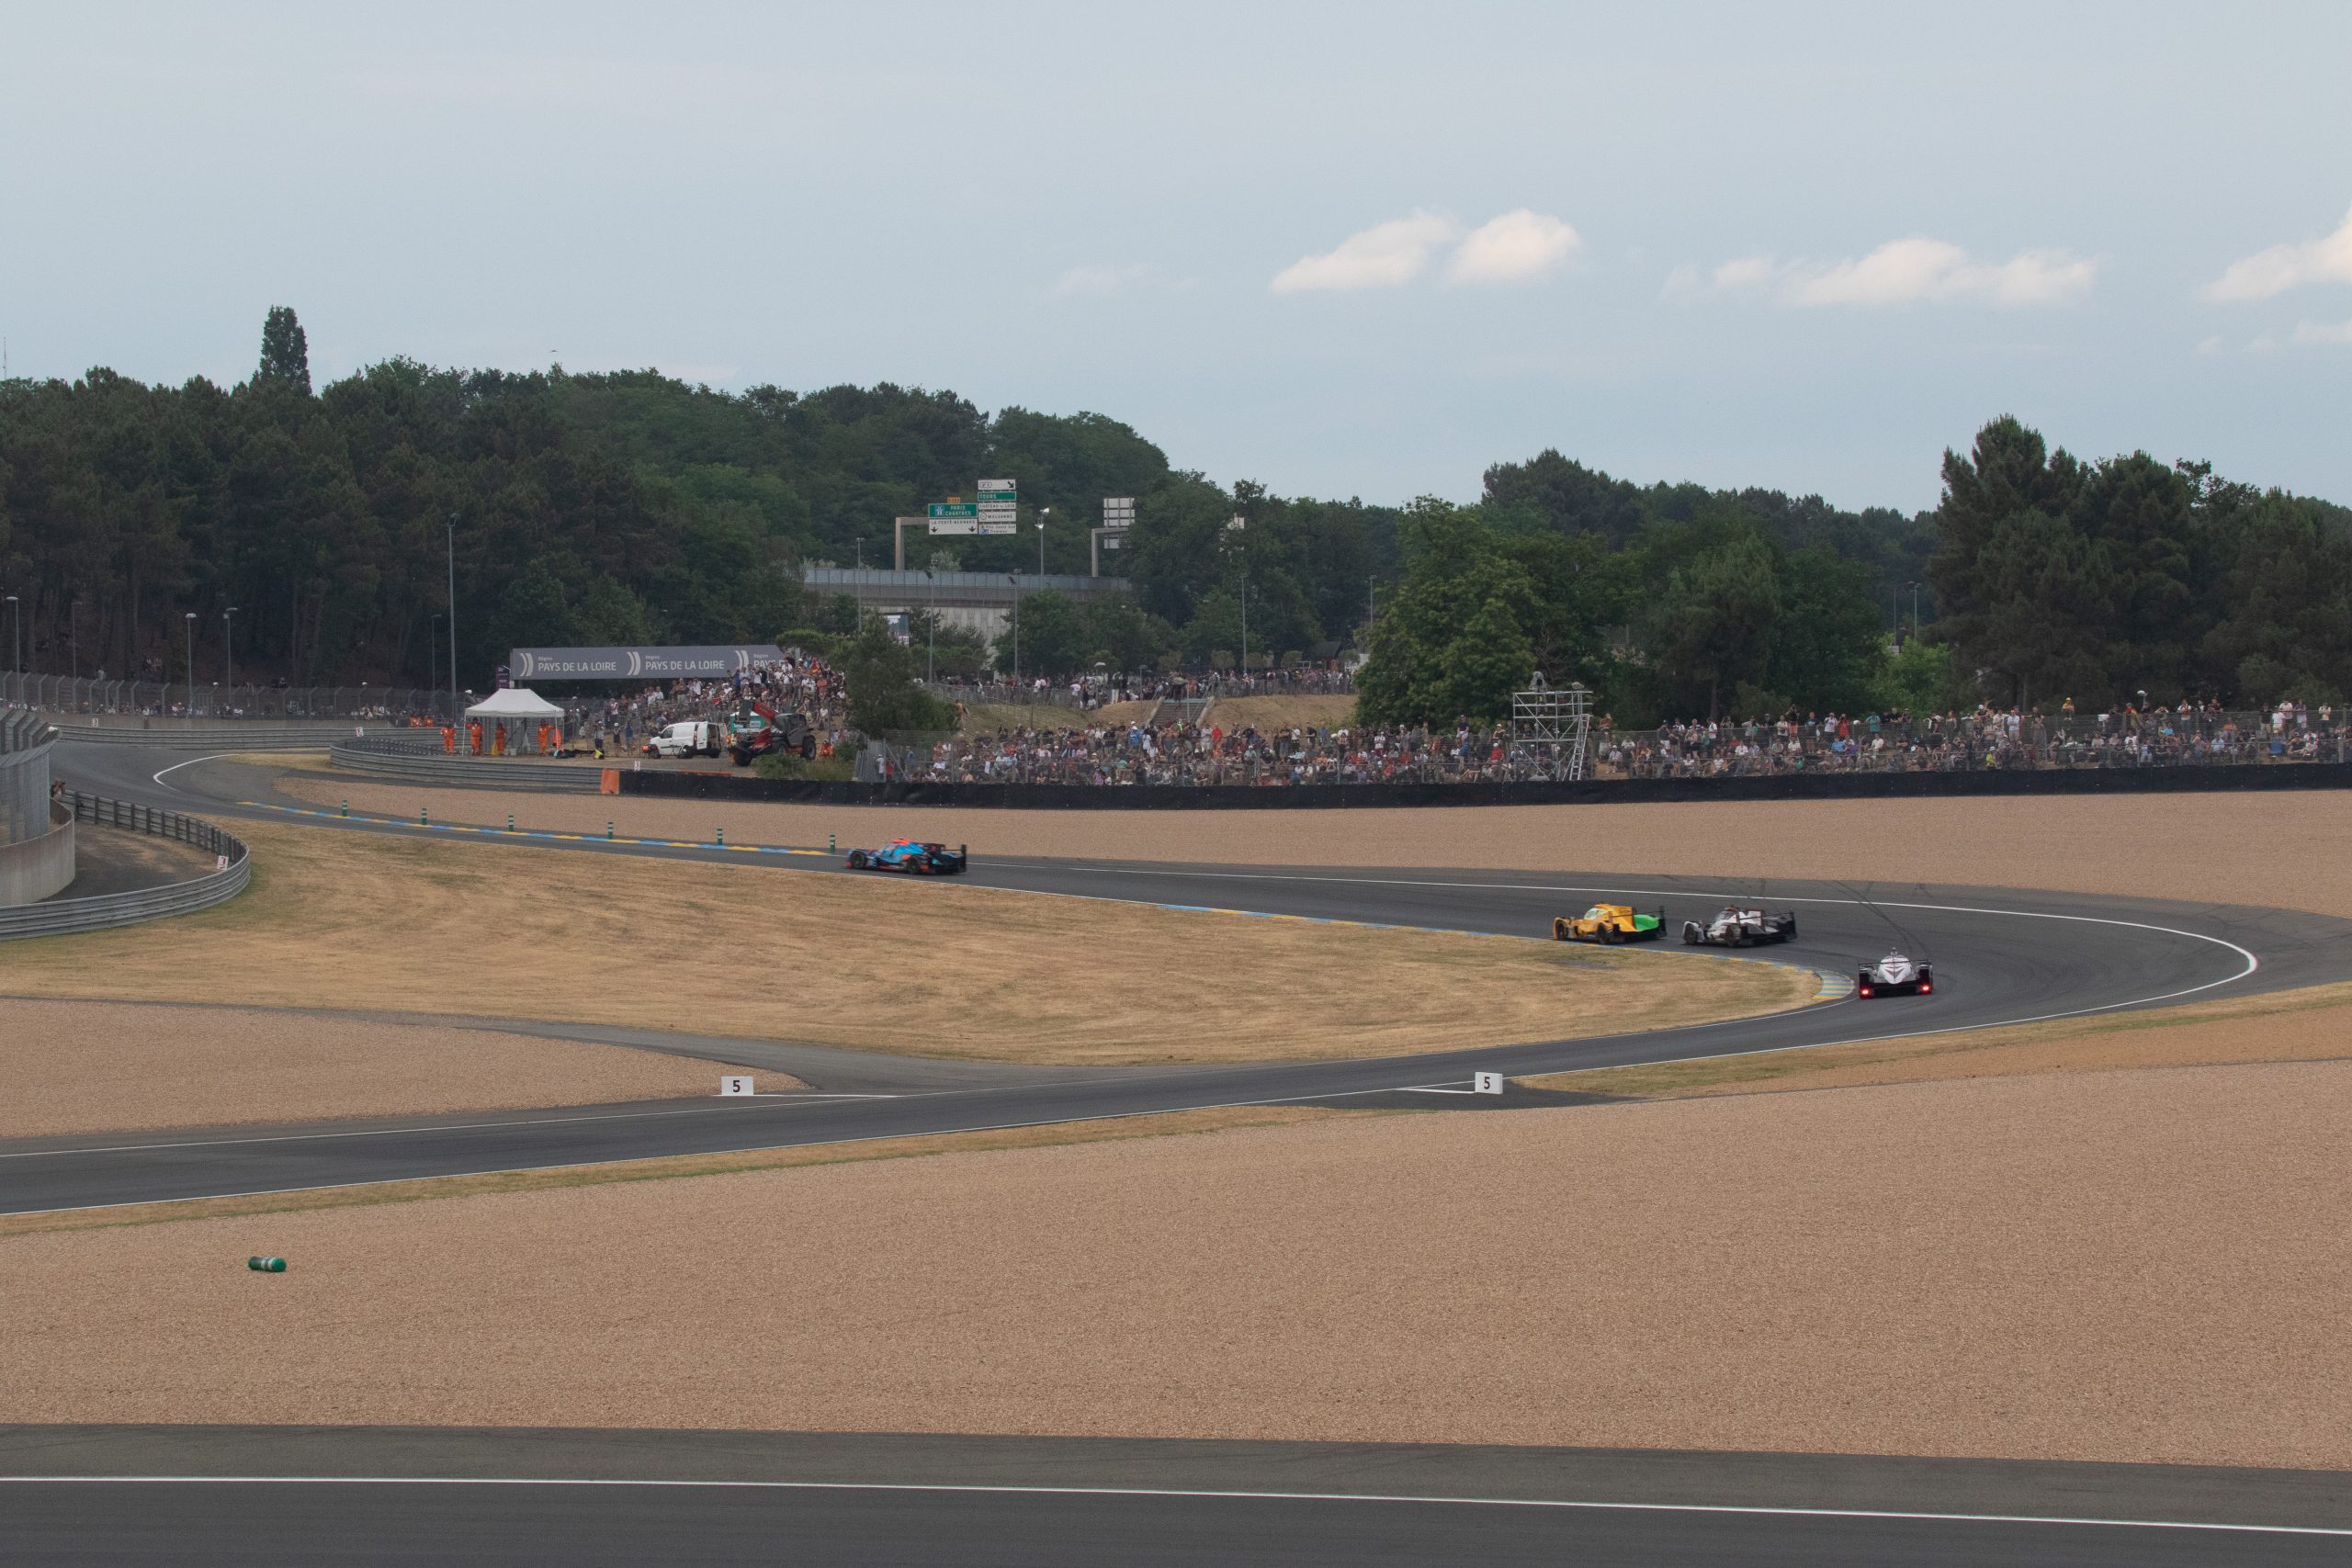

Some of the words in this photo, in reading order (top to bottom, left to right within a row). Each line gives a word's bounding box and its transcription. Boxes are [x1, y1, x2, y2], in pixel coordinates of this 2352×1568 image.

[538, 662, 560, 671] PAYS
[563, 662, 574, 671] DE
[577, 662, 589, 671] LA
[591, 661, 616, 671] LOIRE
[645, 661, 668, 671] PAYS
[671, 661, 683, 670] DE
[684, 661, 695, 670] LA
[699, 660, 725, 670] LOIRE
[753, 660, 776, 669] PAY
[732, 1079, 741, 1093] 5
[1484, 1076, 1490, 1090] 5
